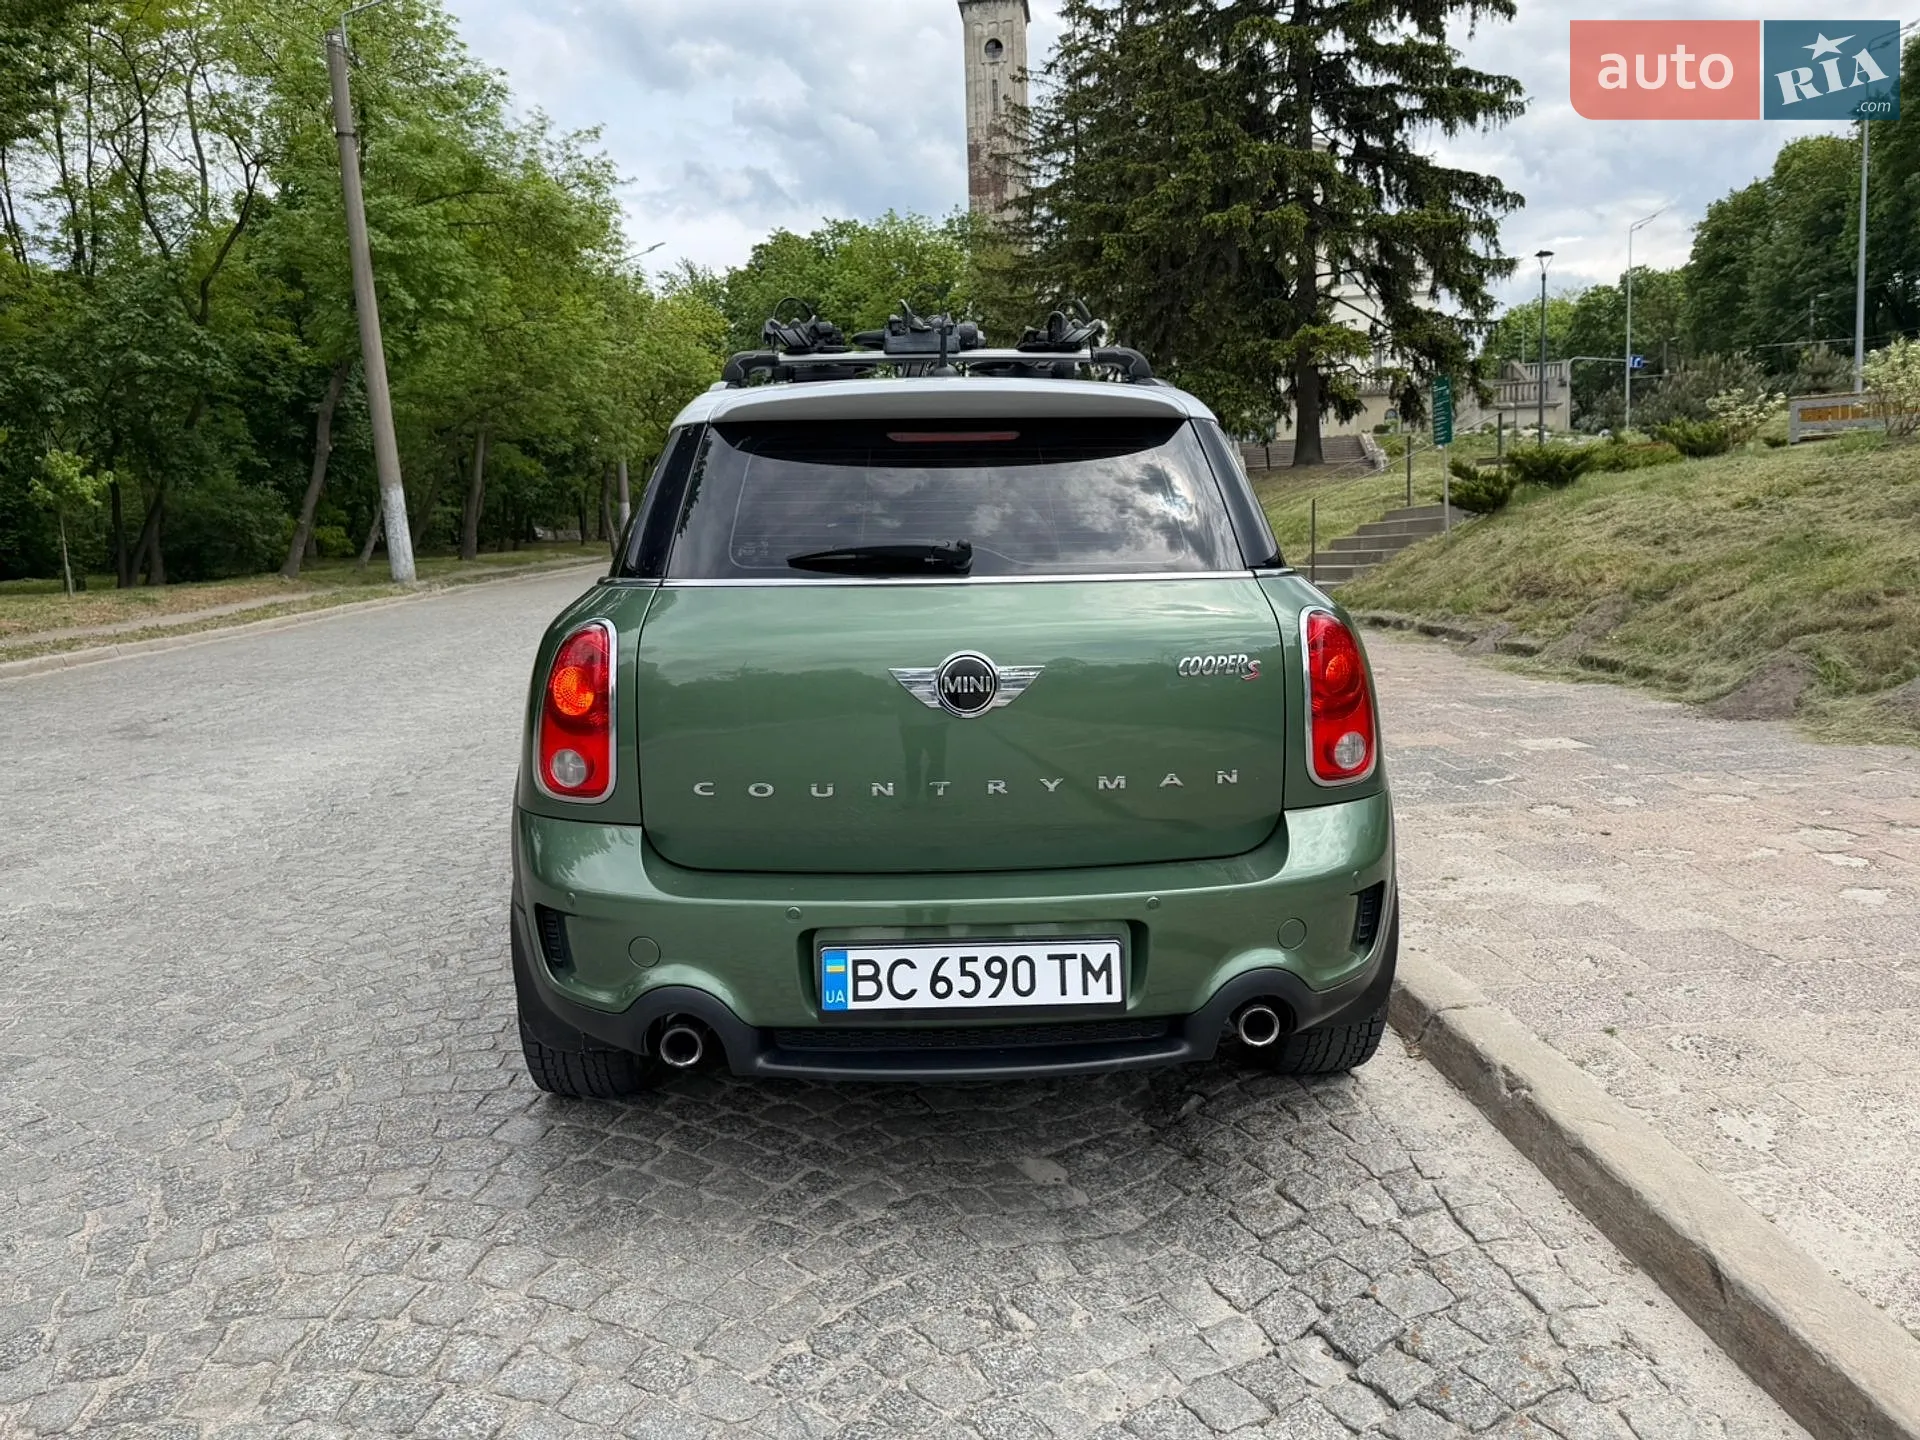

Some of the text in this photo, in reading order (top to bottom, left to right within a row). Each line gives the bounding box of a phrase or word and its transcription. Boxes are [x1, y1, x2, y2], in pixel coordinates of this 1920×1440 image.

[943, 675, 992, 694] MINI
[692, 769, 1239, 798] COUNTRYMAN
[851, 952, 1113, 1002] BC 6590 TM
[825, 990, 845, 1003] UA
